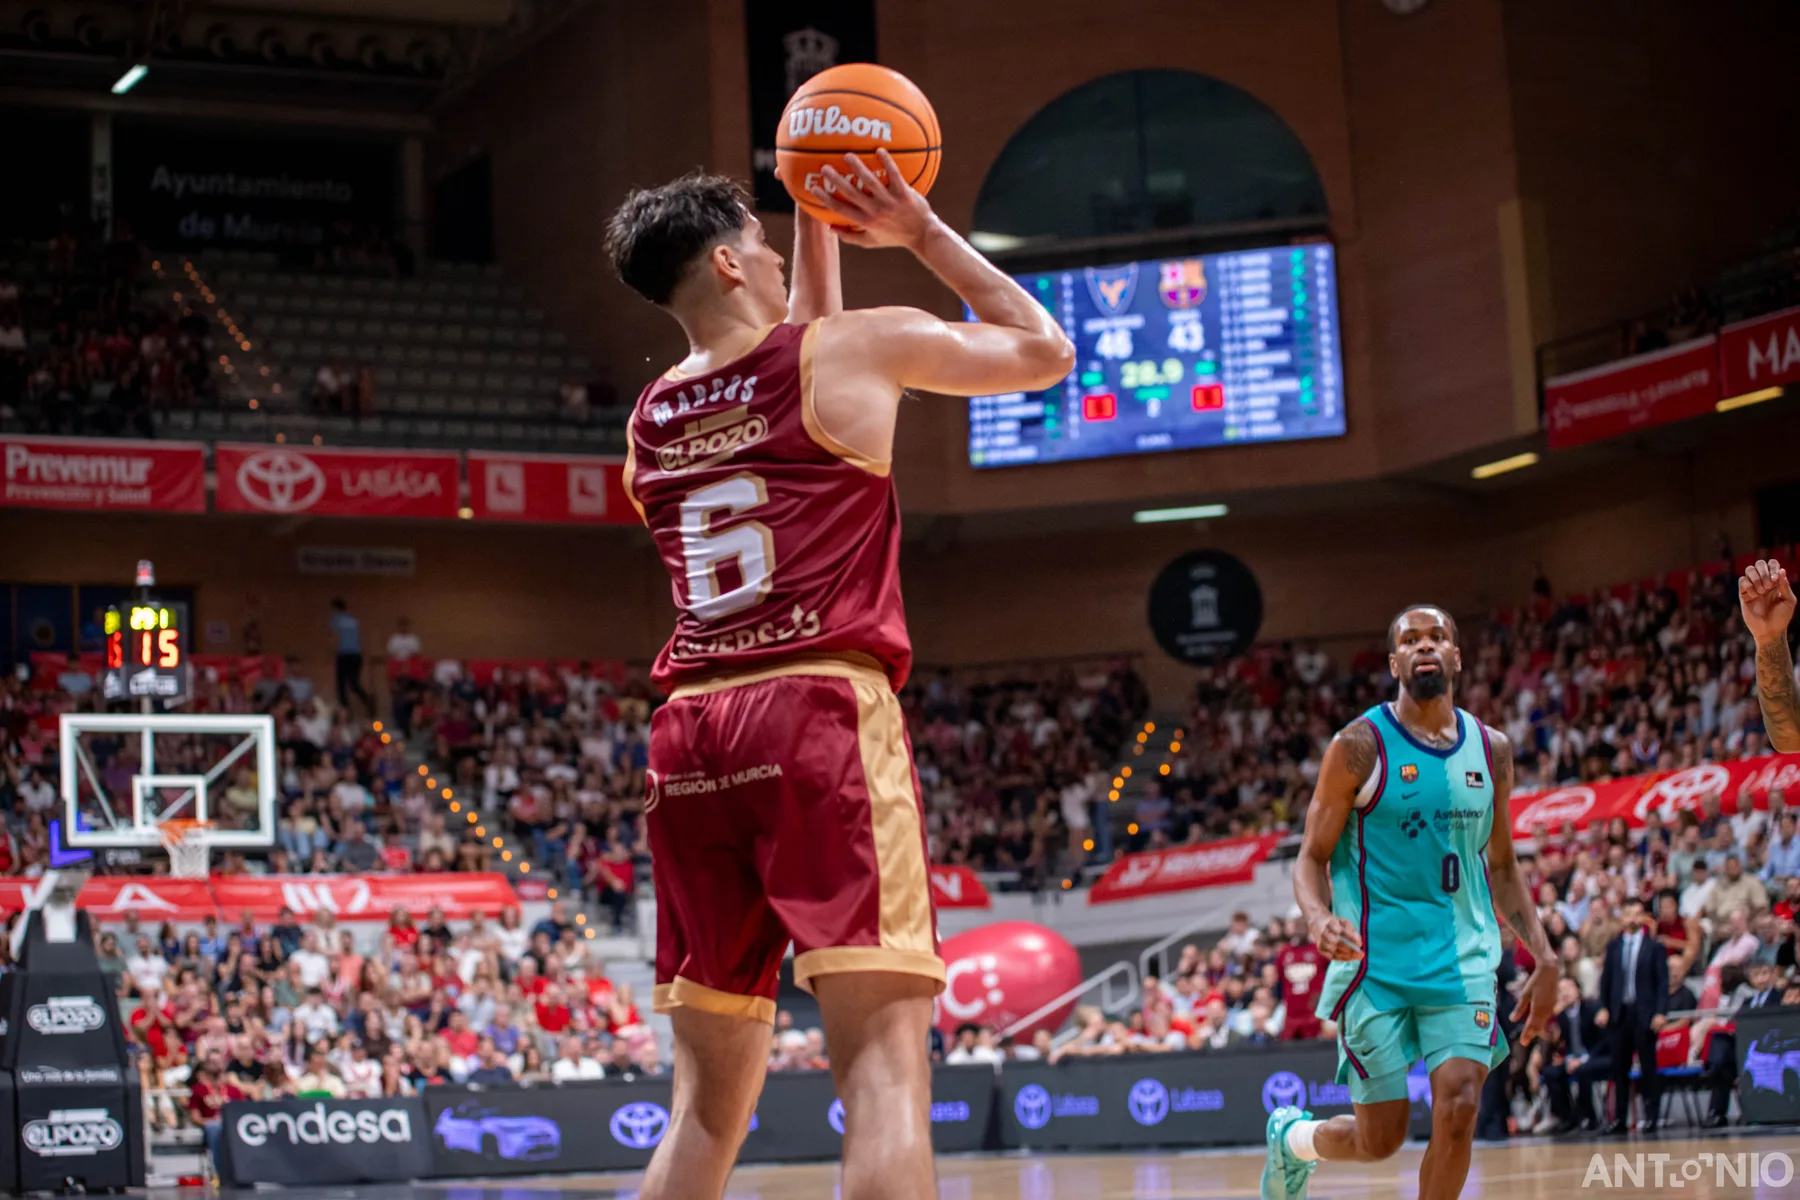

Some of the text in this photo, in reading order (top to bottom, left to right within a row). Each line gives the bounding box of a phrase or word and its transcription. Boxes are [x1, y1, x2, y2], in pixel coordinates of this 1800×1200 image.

[788, 105, 892, 142] Wilson
[149, 164, 353, 203] Ayuntamiento
[5, 445, 152, 484] Prevemur
[680, 470, 776, 622] 6
[141, 629, 179, 668] 15
[1441, 852, 1460, 894] 0
[237, 1102, 412, 1146] endesa
